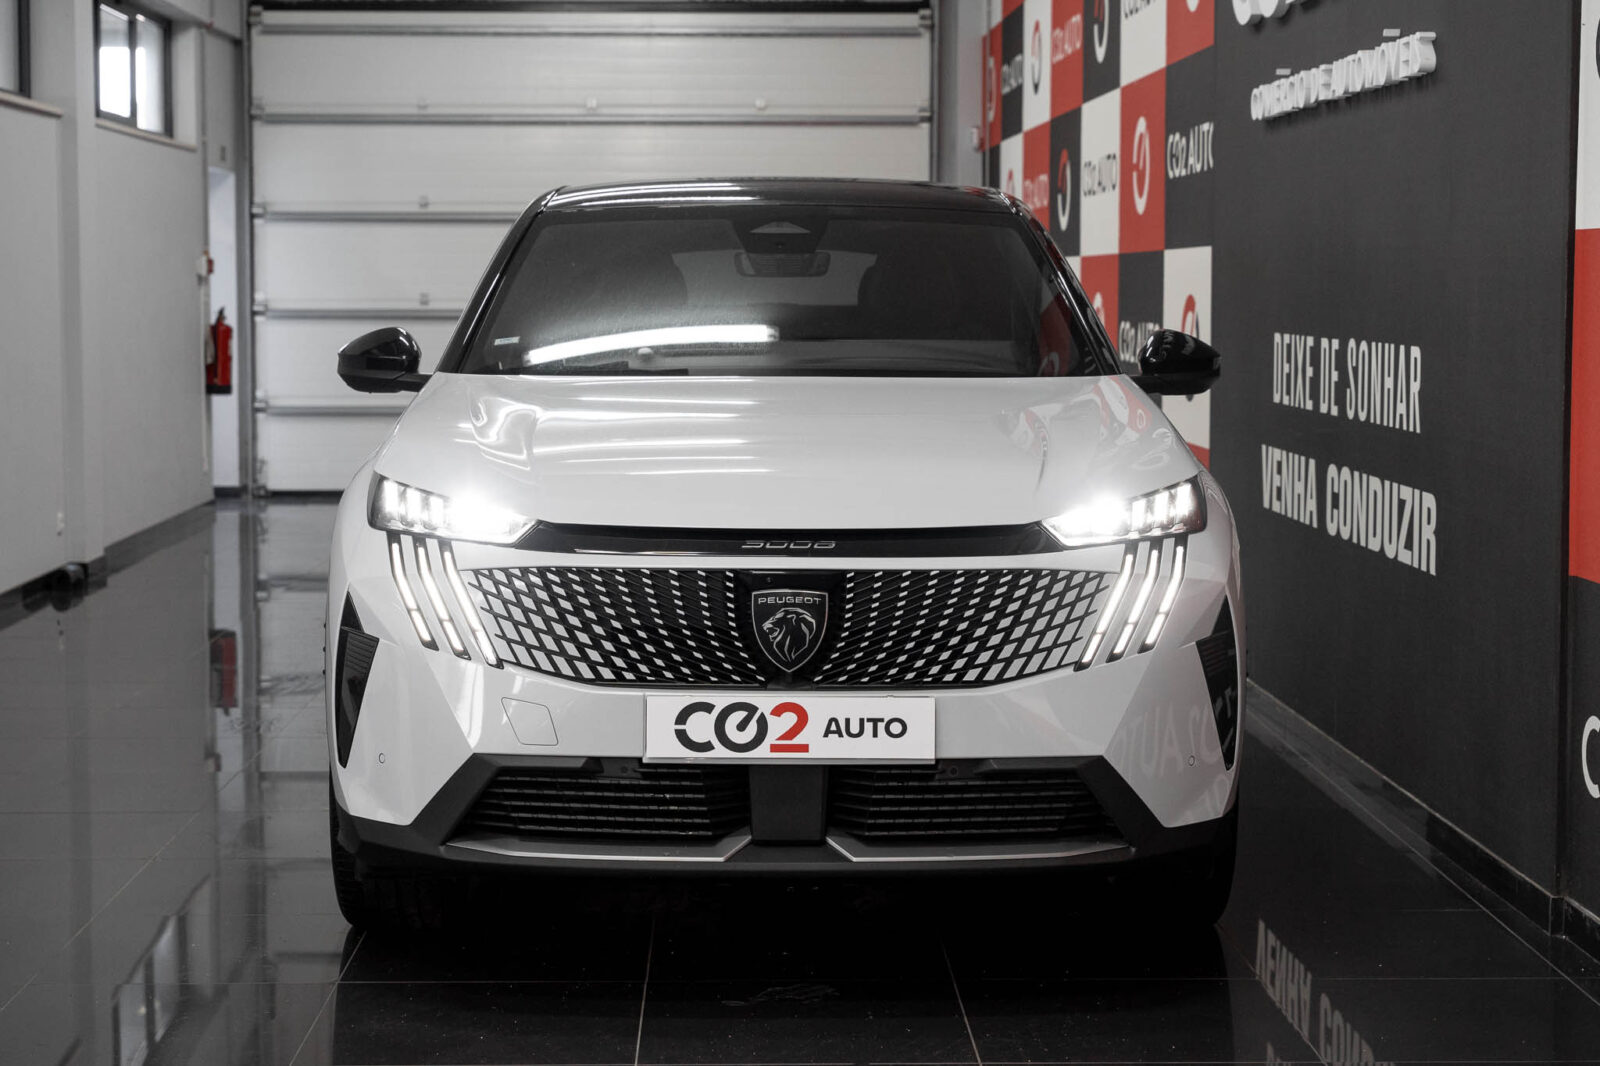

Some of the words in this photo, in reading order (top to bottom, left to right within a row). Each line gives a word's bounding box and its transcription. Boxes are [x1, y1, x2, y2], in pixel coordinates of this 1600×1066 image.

[1272, 332, 1315, 411] DEIXE
[1319, 337, 1340, 417] DE
[1346, 337, 1422, 434] SONHAR
[1261, 444, 1318, 529] VENHA
[1325, 463, 1437, 576] CONDUZIR
[758, 595, 822, 605] PEUGEOT
[822, 716, 908, 739] AUTO
